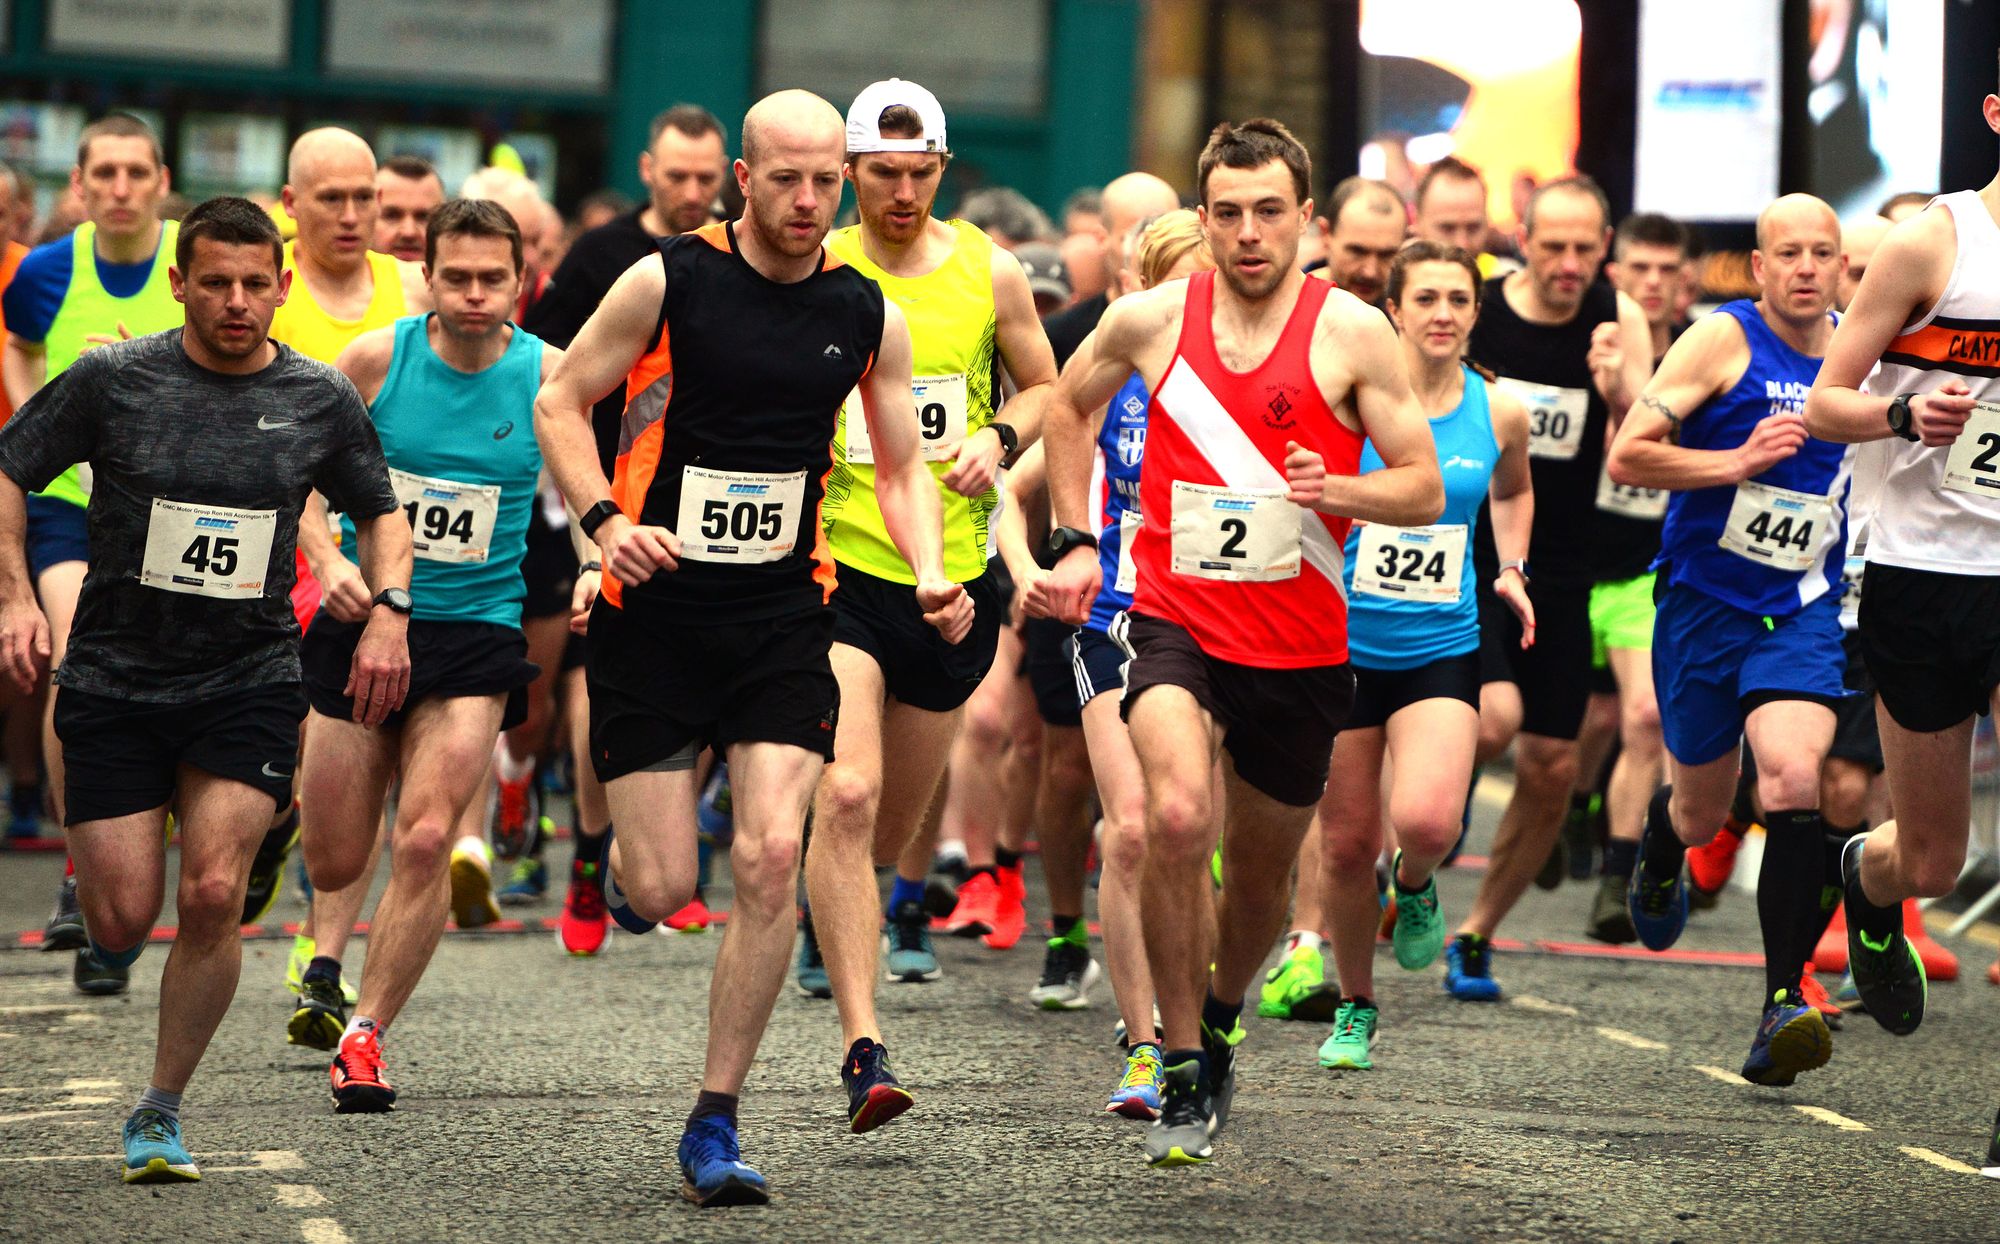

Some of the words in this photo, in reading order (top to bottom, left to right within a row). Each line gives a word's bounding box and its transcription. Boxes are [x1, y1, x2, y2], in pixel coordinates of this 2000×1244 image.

[163, 503, 176, 511] GMC
[177, 505, 193, 513] Motor
[193, 508, 211, 516] Group
[234, 512, 261, 520] Accrington
[403, 500, 474, 544] 194
[701, 499, 784, 542] 505
[1745, 510, 1814, 552] 444
[181, 534, 240, 577] 45
[1220, 518, 1247, 559] 2
[1375, 544, 1446, 583] 324
